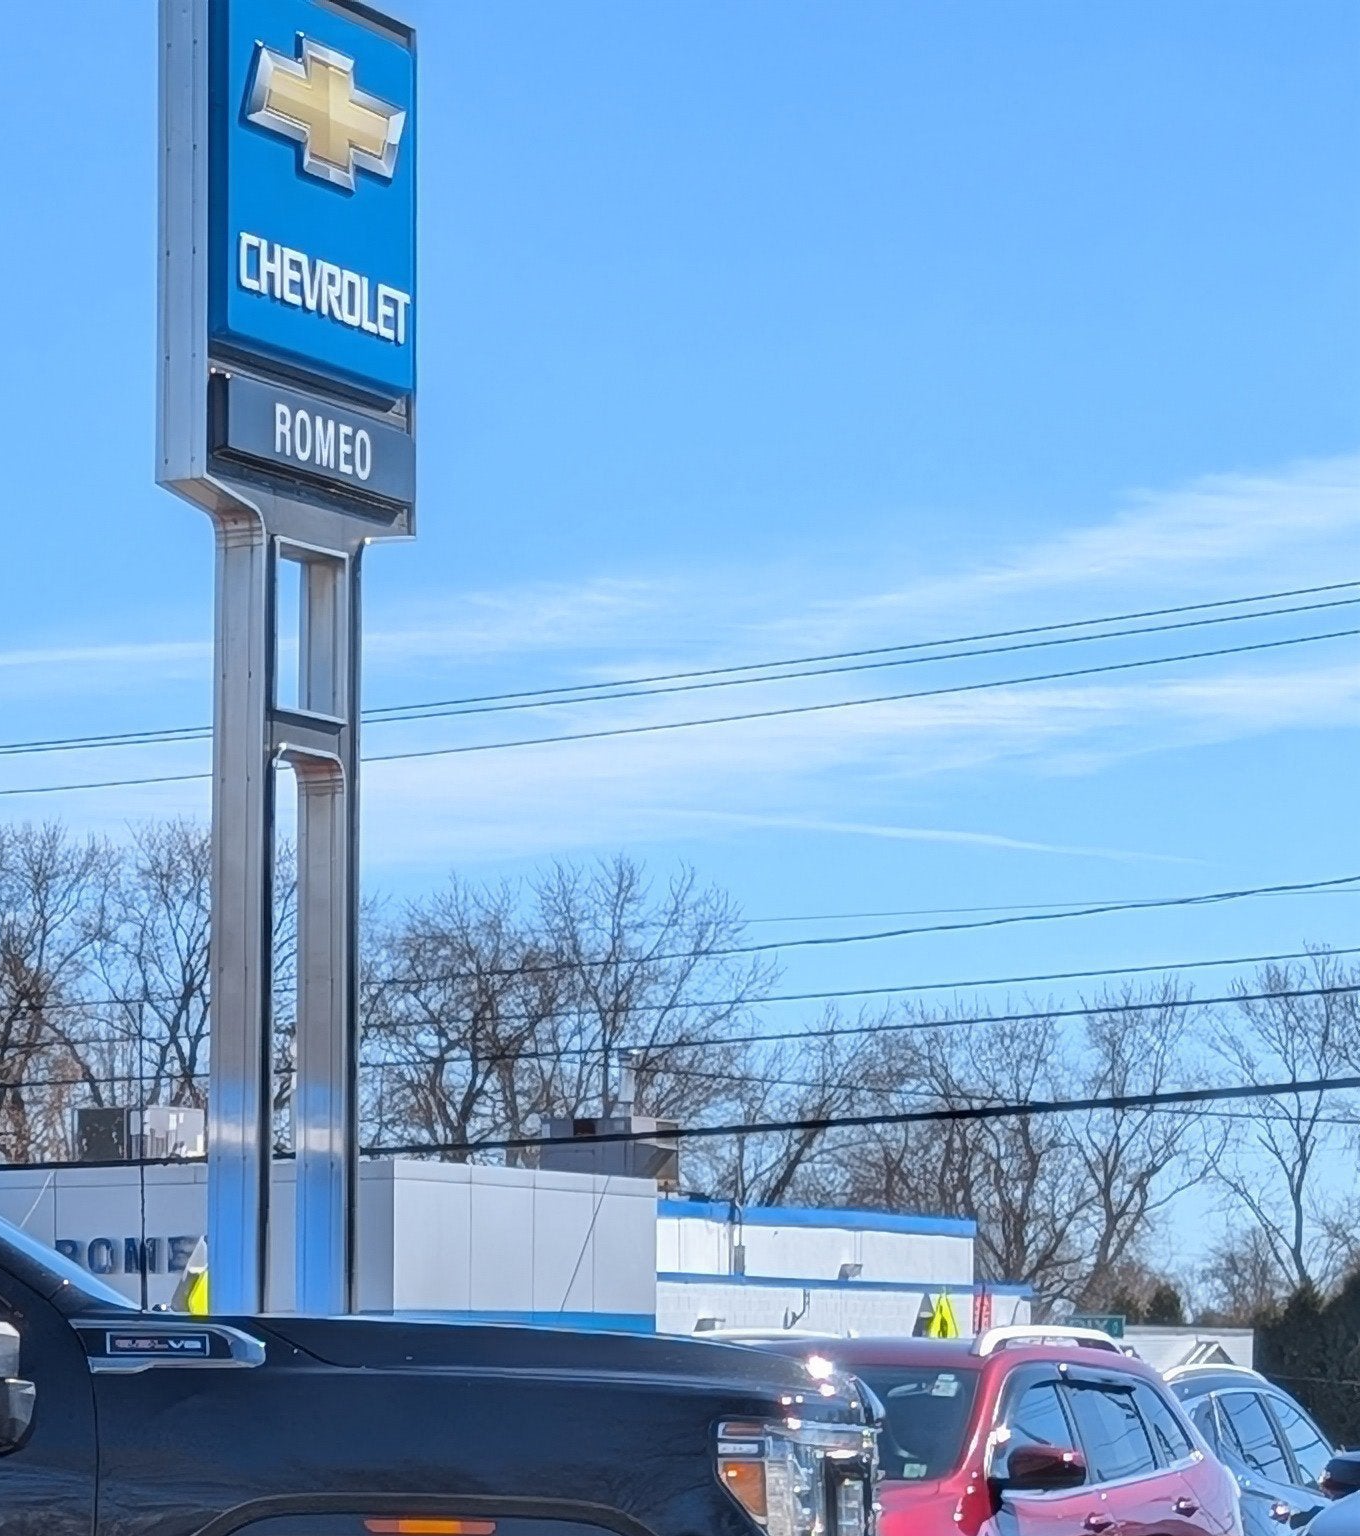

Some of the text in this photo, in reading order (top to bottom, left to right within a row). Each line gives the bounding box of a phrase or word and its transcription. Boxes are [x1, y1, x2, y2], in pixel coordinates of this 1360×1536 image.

[239, 231, 410, 345] CHEVROLET
[275, 403, 371, 481] ROMEO
[55, 1236, 208, 1274] ROME
